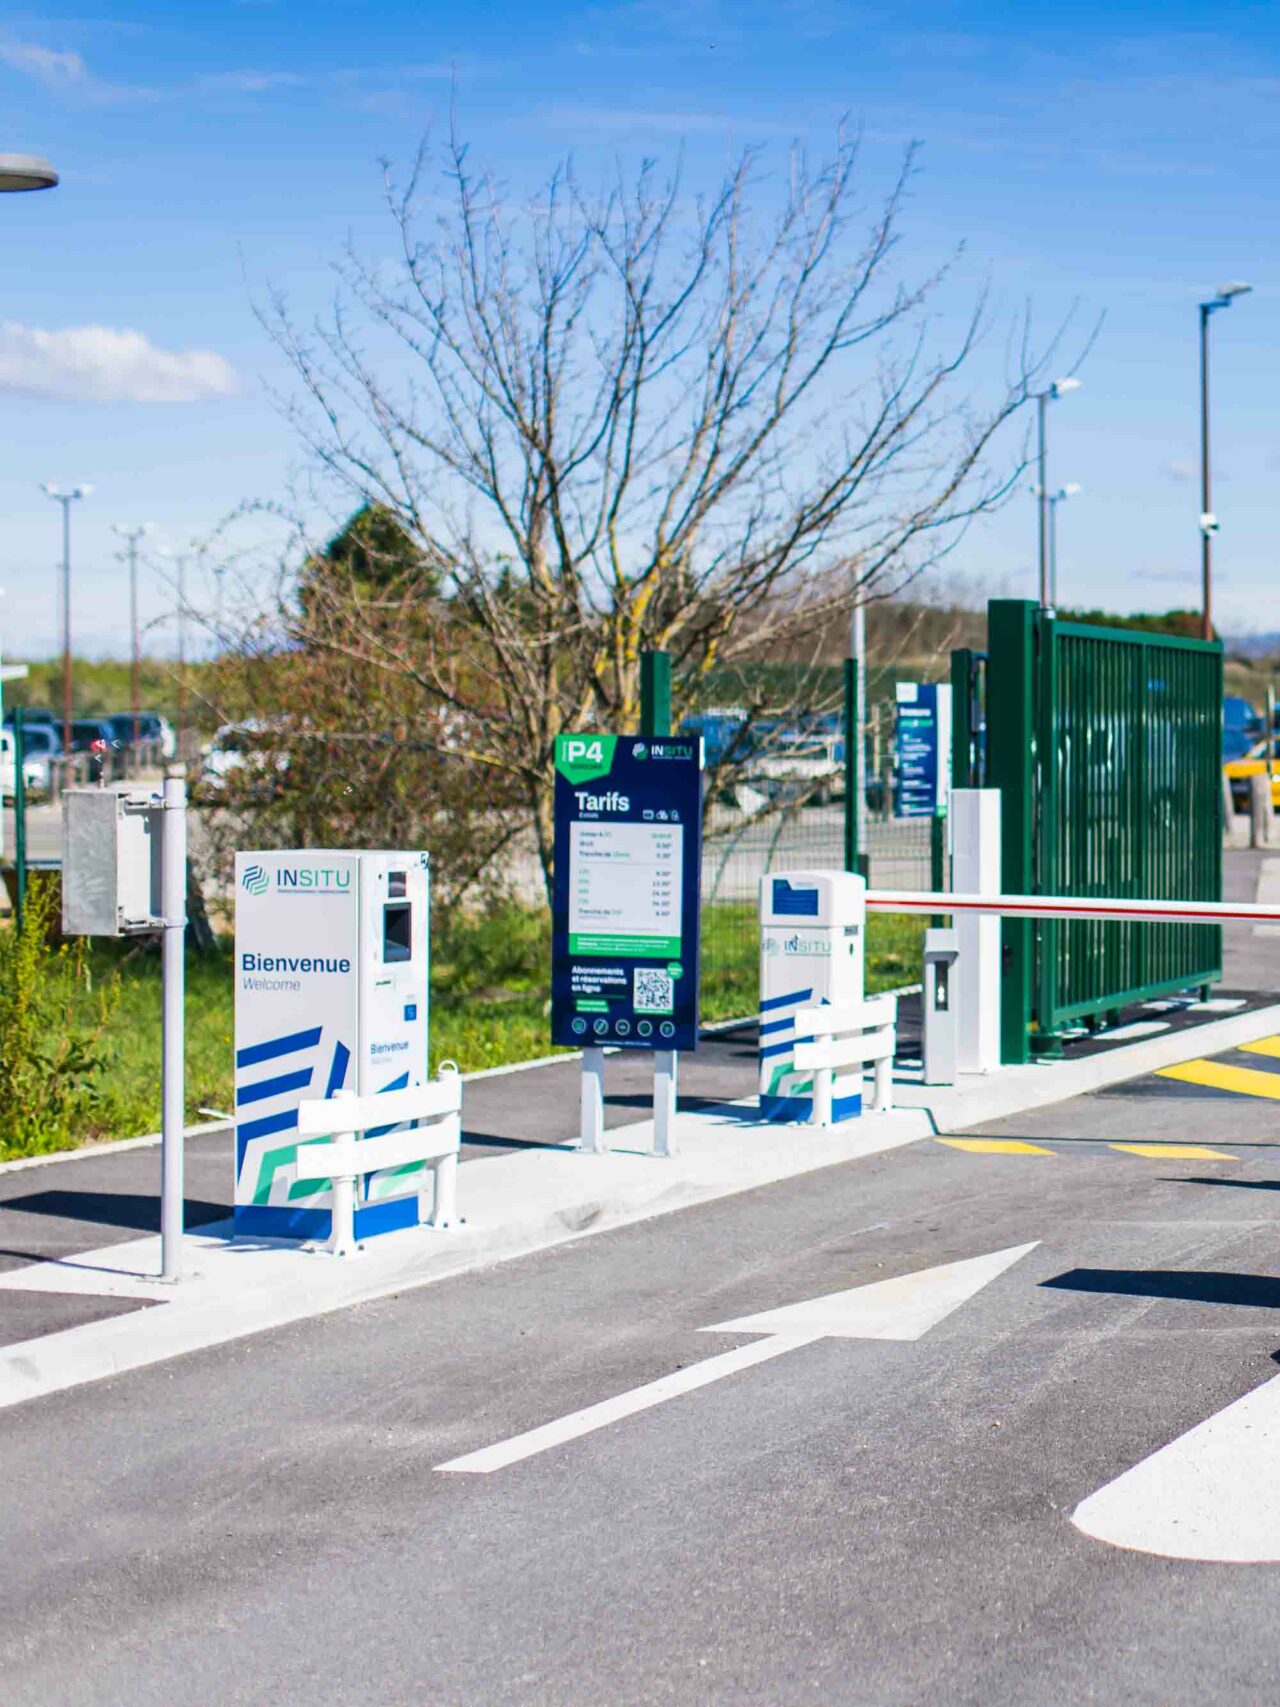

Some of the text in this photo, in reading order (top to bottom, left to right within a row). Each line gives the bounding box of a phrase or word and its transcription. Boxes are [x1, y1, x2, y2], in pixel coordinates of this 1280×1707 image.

[568, 741, 603, 762] P4
[651, 744, 692, 757] INSITU
[574, 791, 630, 812] Tarifs
[277, 869, 350, 887] INSITU
[784, 939, 832, 952] INSITU
[242, 953, 351, 973] Bienvenue
[242, 977, 301, 991] Welcome
[370, 1041, 409, 1055] Bienvenue
